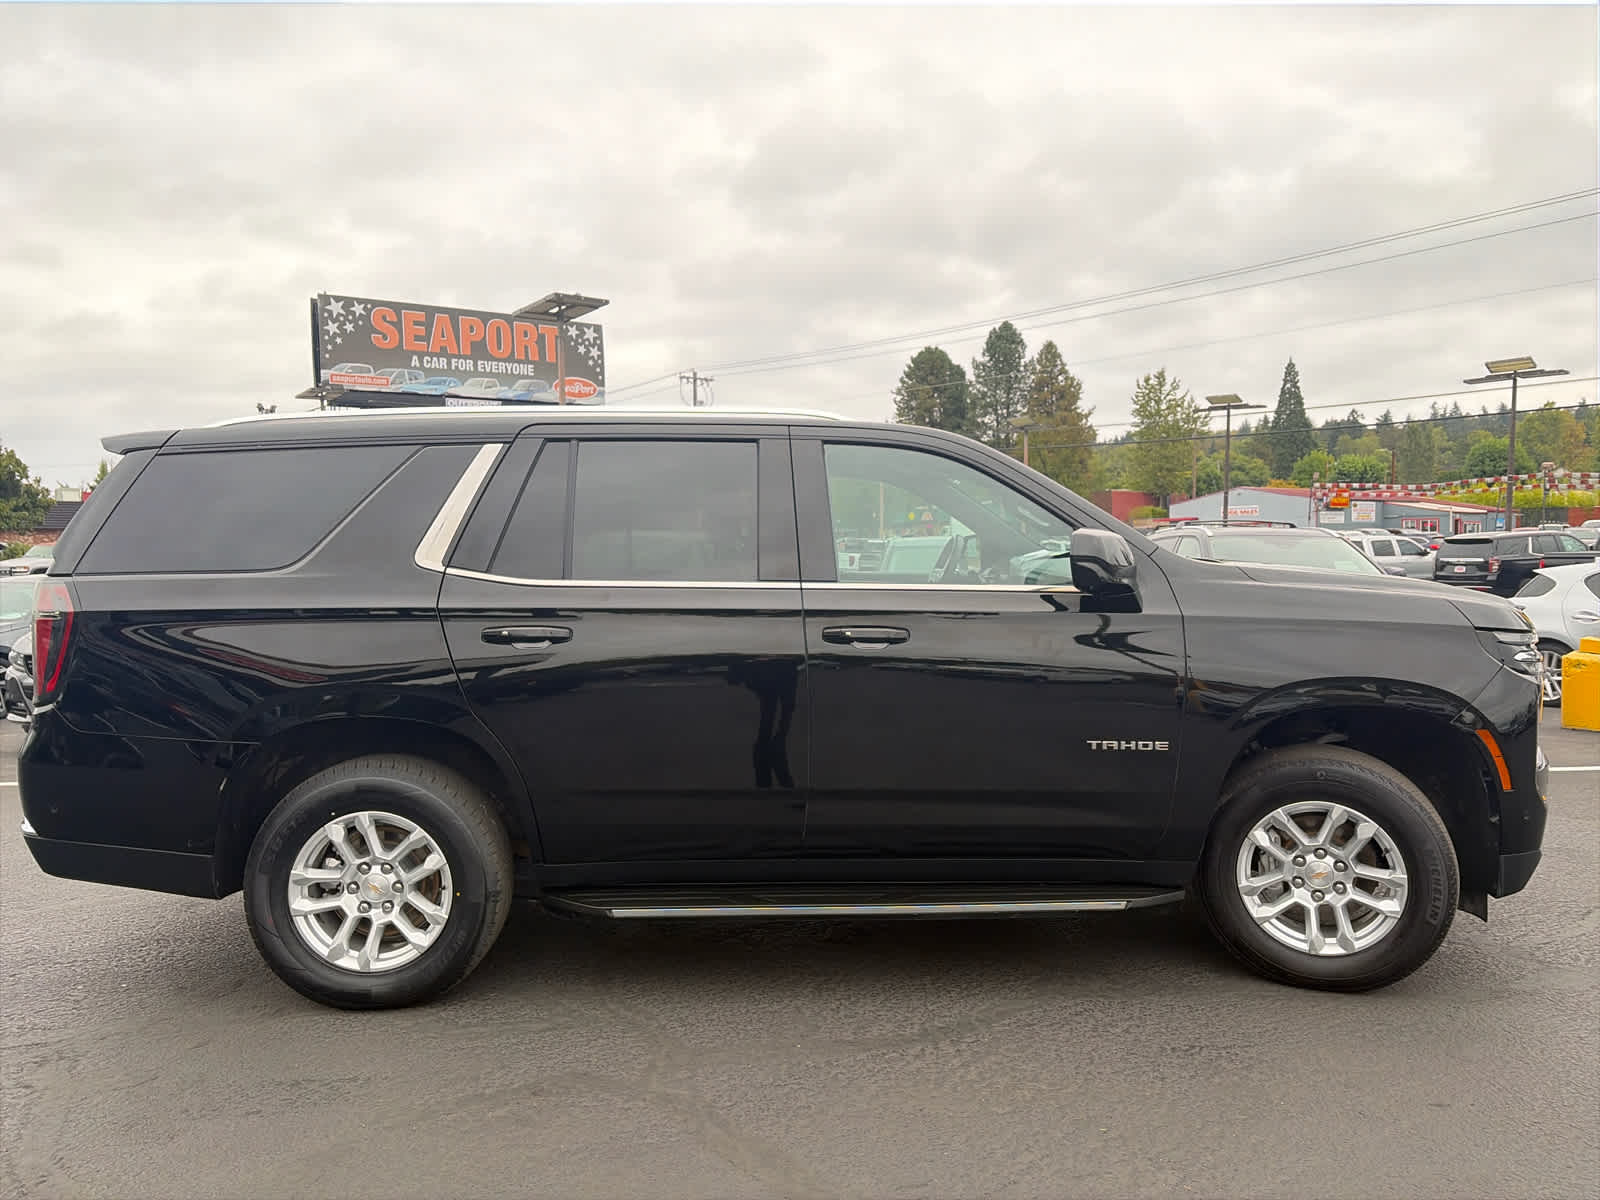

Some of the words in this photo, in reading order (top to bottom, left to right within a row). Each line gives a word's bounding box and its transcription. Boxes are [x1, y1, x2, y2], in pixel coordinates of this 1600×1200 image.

[370, 306, 559, 363] SEAPORT
[411, 355, 420, 368] A
[423, 356, 448, 370] CAR
[451, 358, 474, 372] FOR
[477, 360, 535, 376] EVERYONE
[1086, 740, 1169, 751] TAHOE
